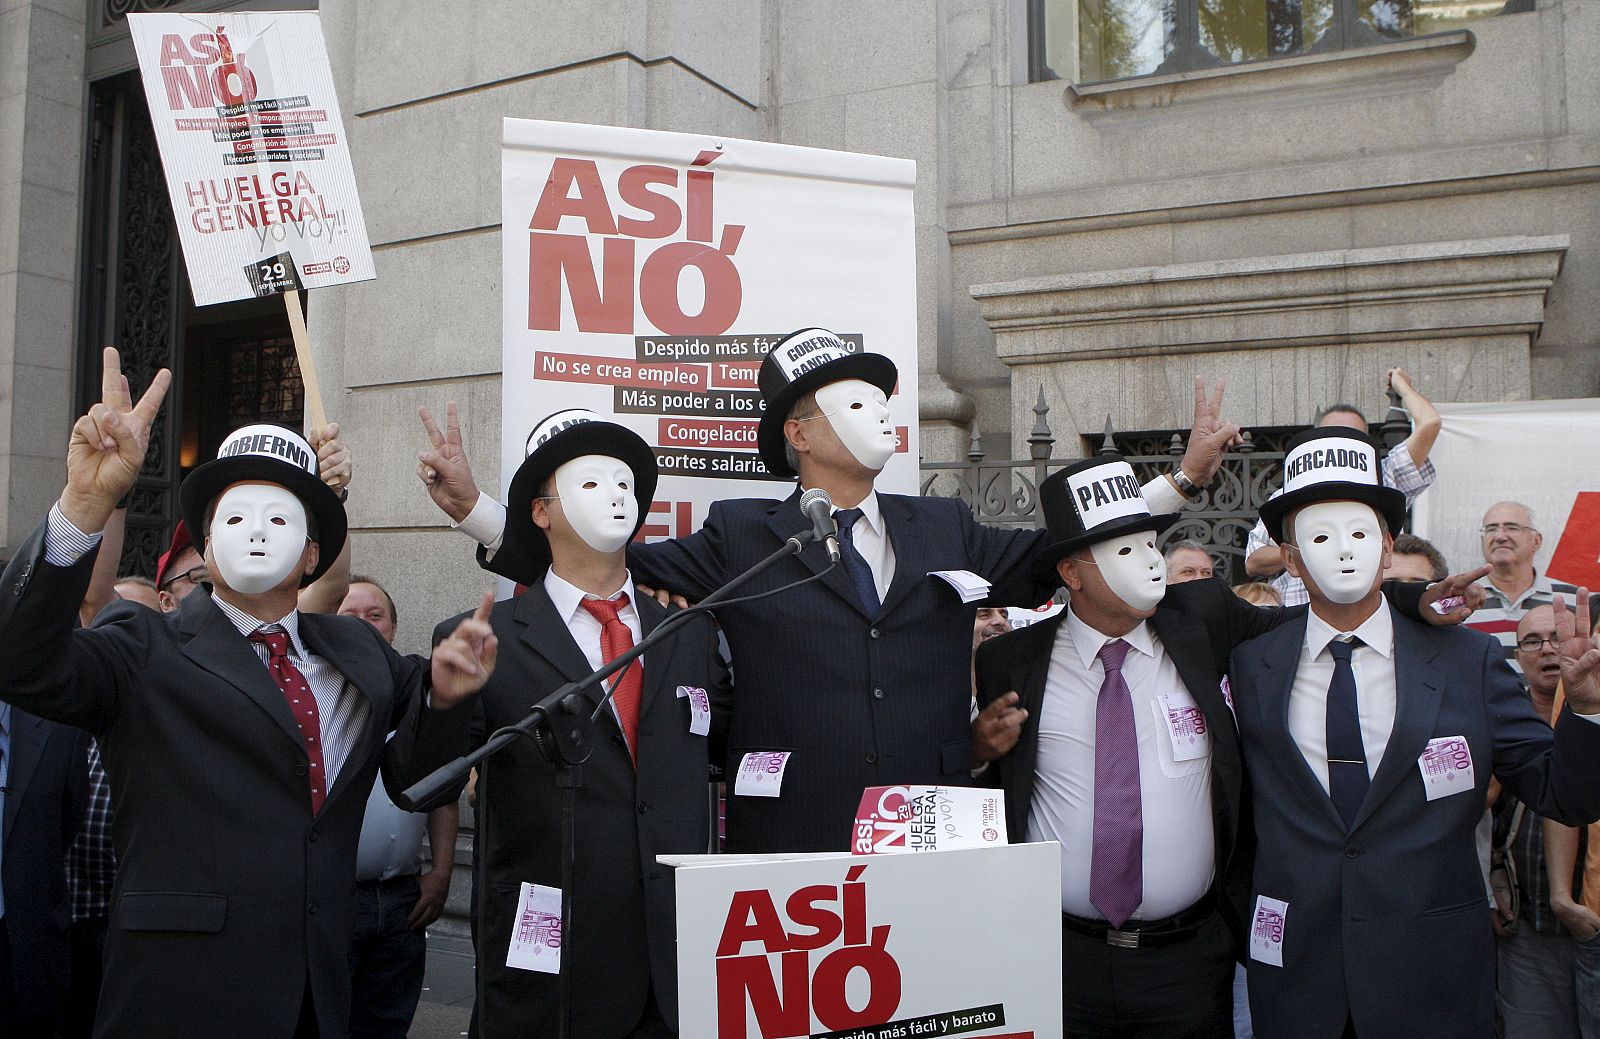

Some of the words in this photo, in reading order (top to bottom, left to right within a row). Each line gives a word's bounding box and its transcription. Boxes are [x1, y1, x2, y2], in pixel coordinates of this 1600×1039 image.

[221, 103, 249, 116] Despido
[250, 102, 264, 110] más
[264, 99, 278, 109] fácil
[283, 98, 306, 107] barato
[253, 113, 299, 122] Temporalidad
[299, 111, 325, 120] abusiva
[219, 119, 247, 129] empleo
[231, 129, 253, 140] poder
[260, 126, 270, 134] los
[270, 124, 311, 135] empresarios
[236, 138, 279, 151] Congelación
[279, 138, 288, 146] de
[226, 153, 257, 163] Recortes
[257, 151, 288, 161] salariales
[294, 151, 321, 160] sociales
[184, 170, 316, 208] HUELGA
[191, 195, 336, 235] GENERAL
[254, 223, 287, 253] yo
[260, 262, 286, 281] 29
[643, 339, 711, 360] Despido
[715, 339, 749, 357] más
[786, 336, 845, 363] GOBERNA
[542, 355, 567, 375] No
[572, 360, 591, 375] se
[596, 360, 633, 379] crea
[638, 361, 700, 388] empleo
[621, 389, 657, 407] Más
[661, 390, 710, 413] poder
[714, 396, 725, 410] a
[729, 393, 754, 411] los
[667, 423, 757, 446] Congelació
[655, 453, 708, 472] cortes
[1287, 448, 1368, 484] MERCADOS
[1191, 709, 1205, 735] 500
[767, 751, 785, 774] 500
[1450, 742, 1470, 770] 500
[897, 802, 912, 820] 29
[924, 786, 937, 852] GENERAL
[910, 795, 924, 852] HUELGA
[945, 822, 963, 840] yo
[547, 916, 562, 949] 500
[1271, 918, 1283, 943] 500
[880, 1024, 907, 1039] más
[909, 1014, 938, 1035] fácil
[940, 1020, 950, 1033] y
[952, 1010, 997, 1029] barato
